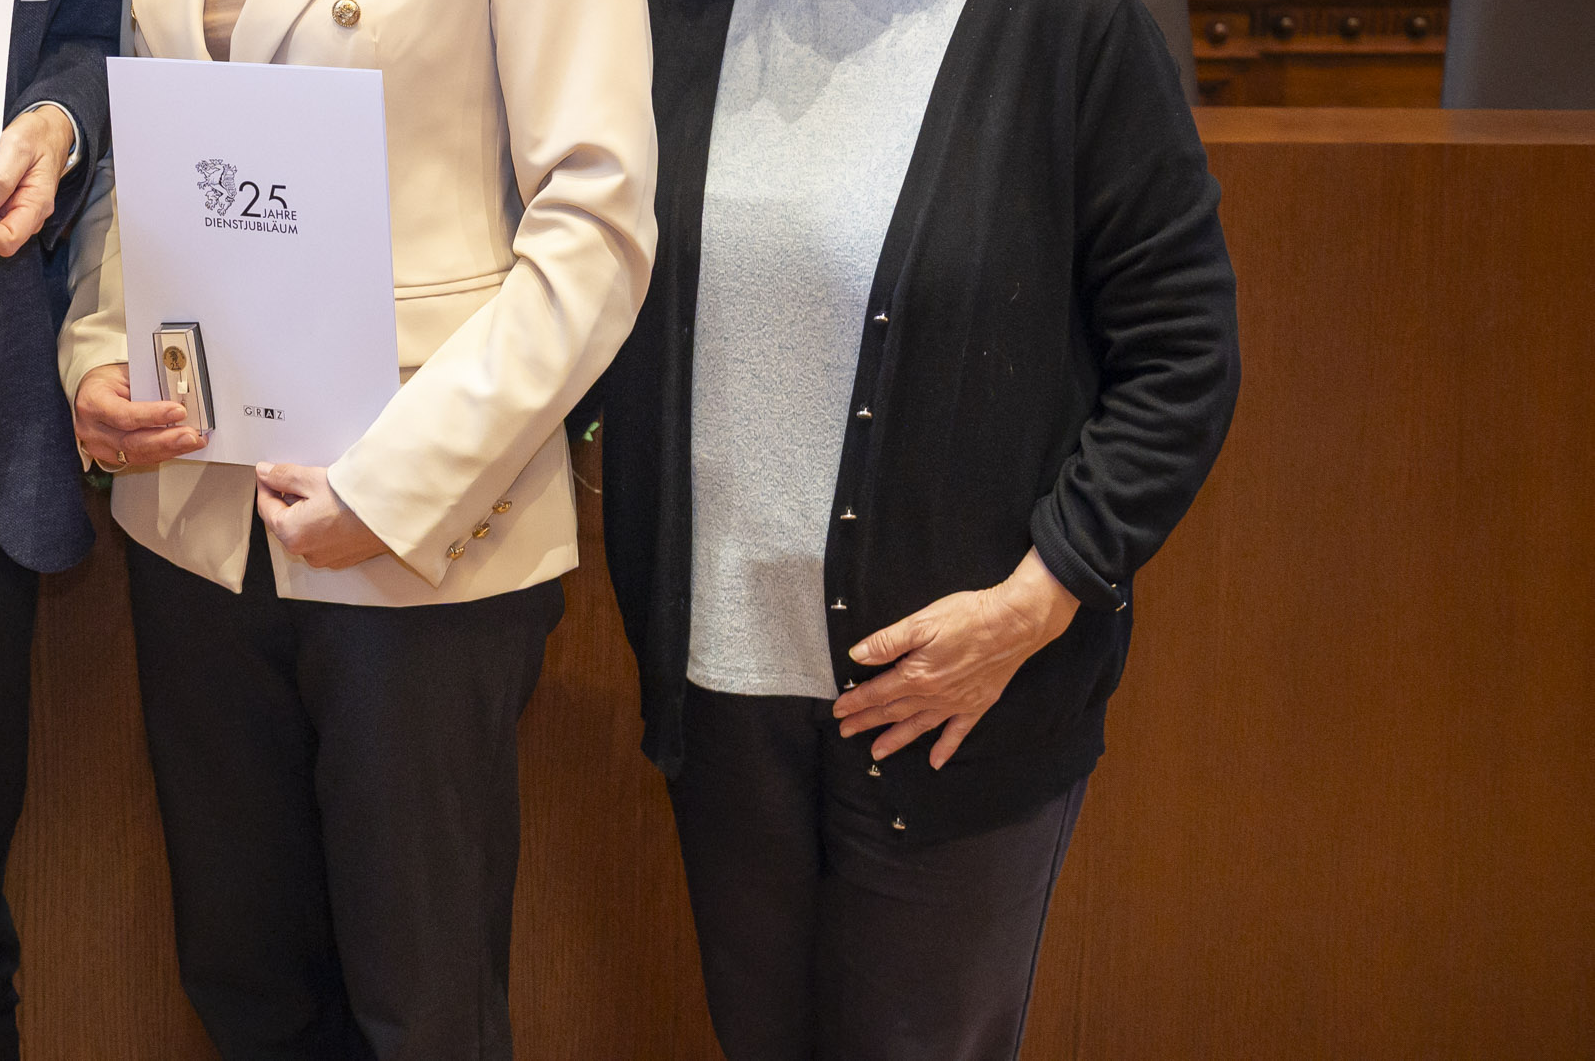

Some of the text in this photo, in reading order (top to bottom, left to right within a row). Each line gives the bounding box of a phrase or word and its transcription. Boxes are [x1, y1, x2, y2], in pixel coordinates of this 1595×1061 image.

[238, 181, 298, 221] 25 JAHRE
[204, 217, 299, 235] DIENSTJUBILÄUM
[244, 406, 284, 420] GRAZ
